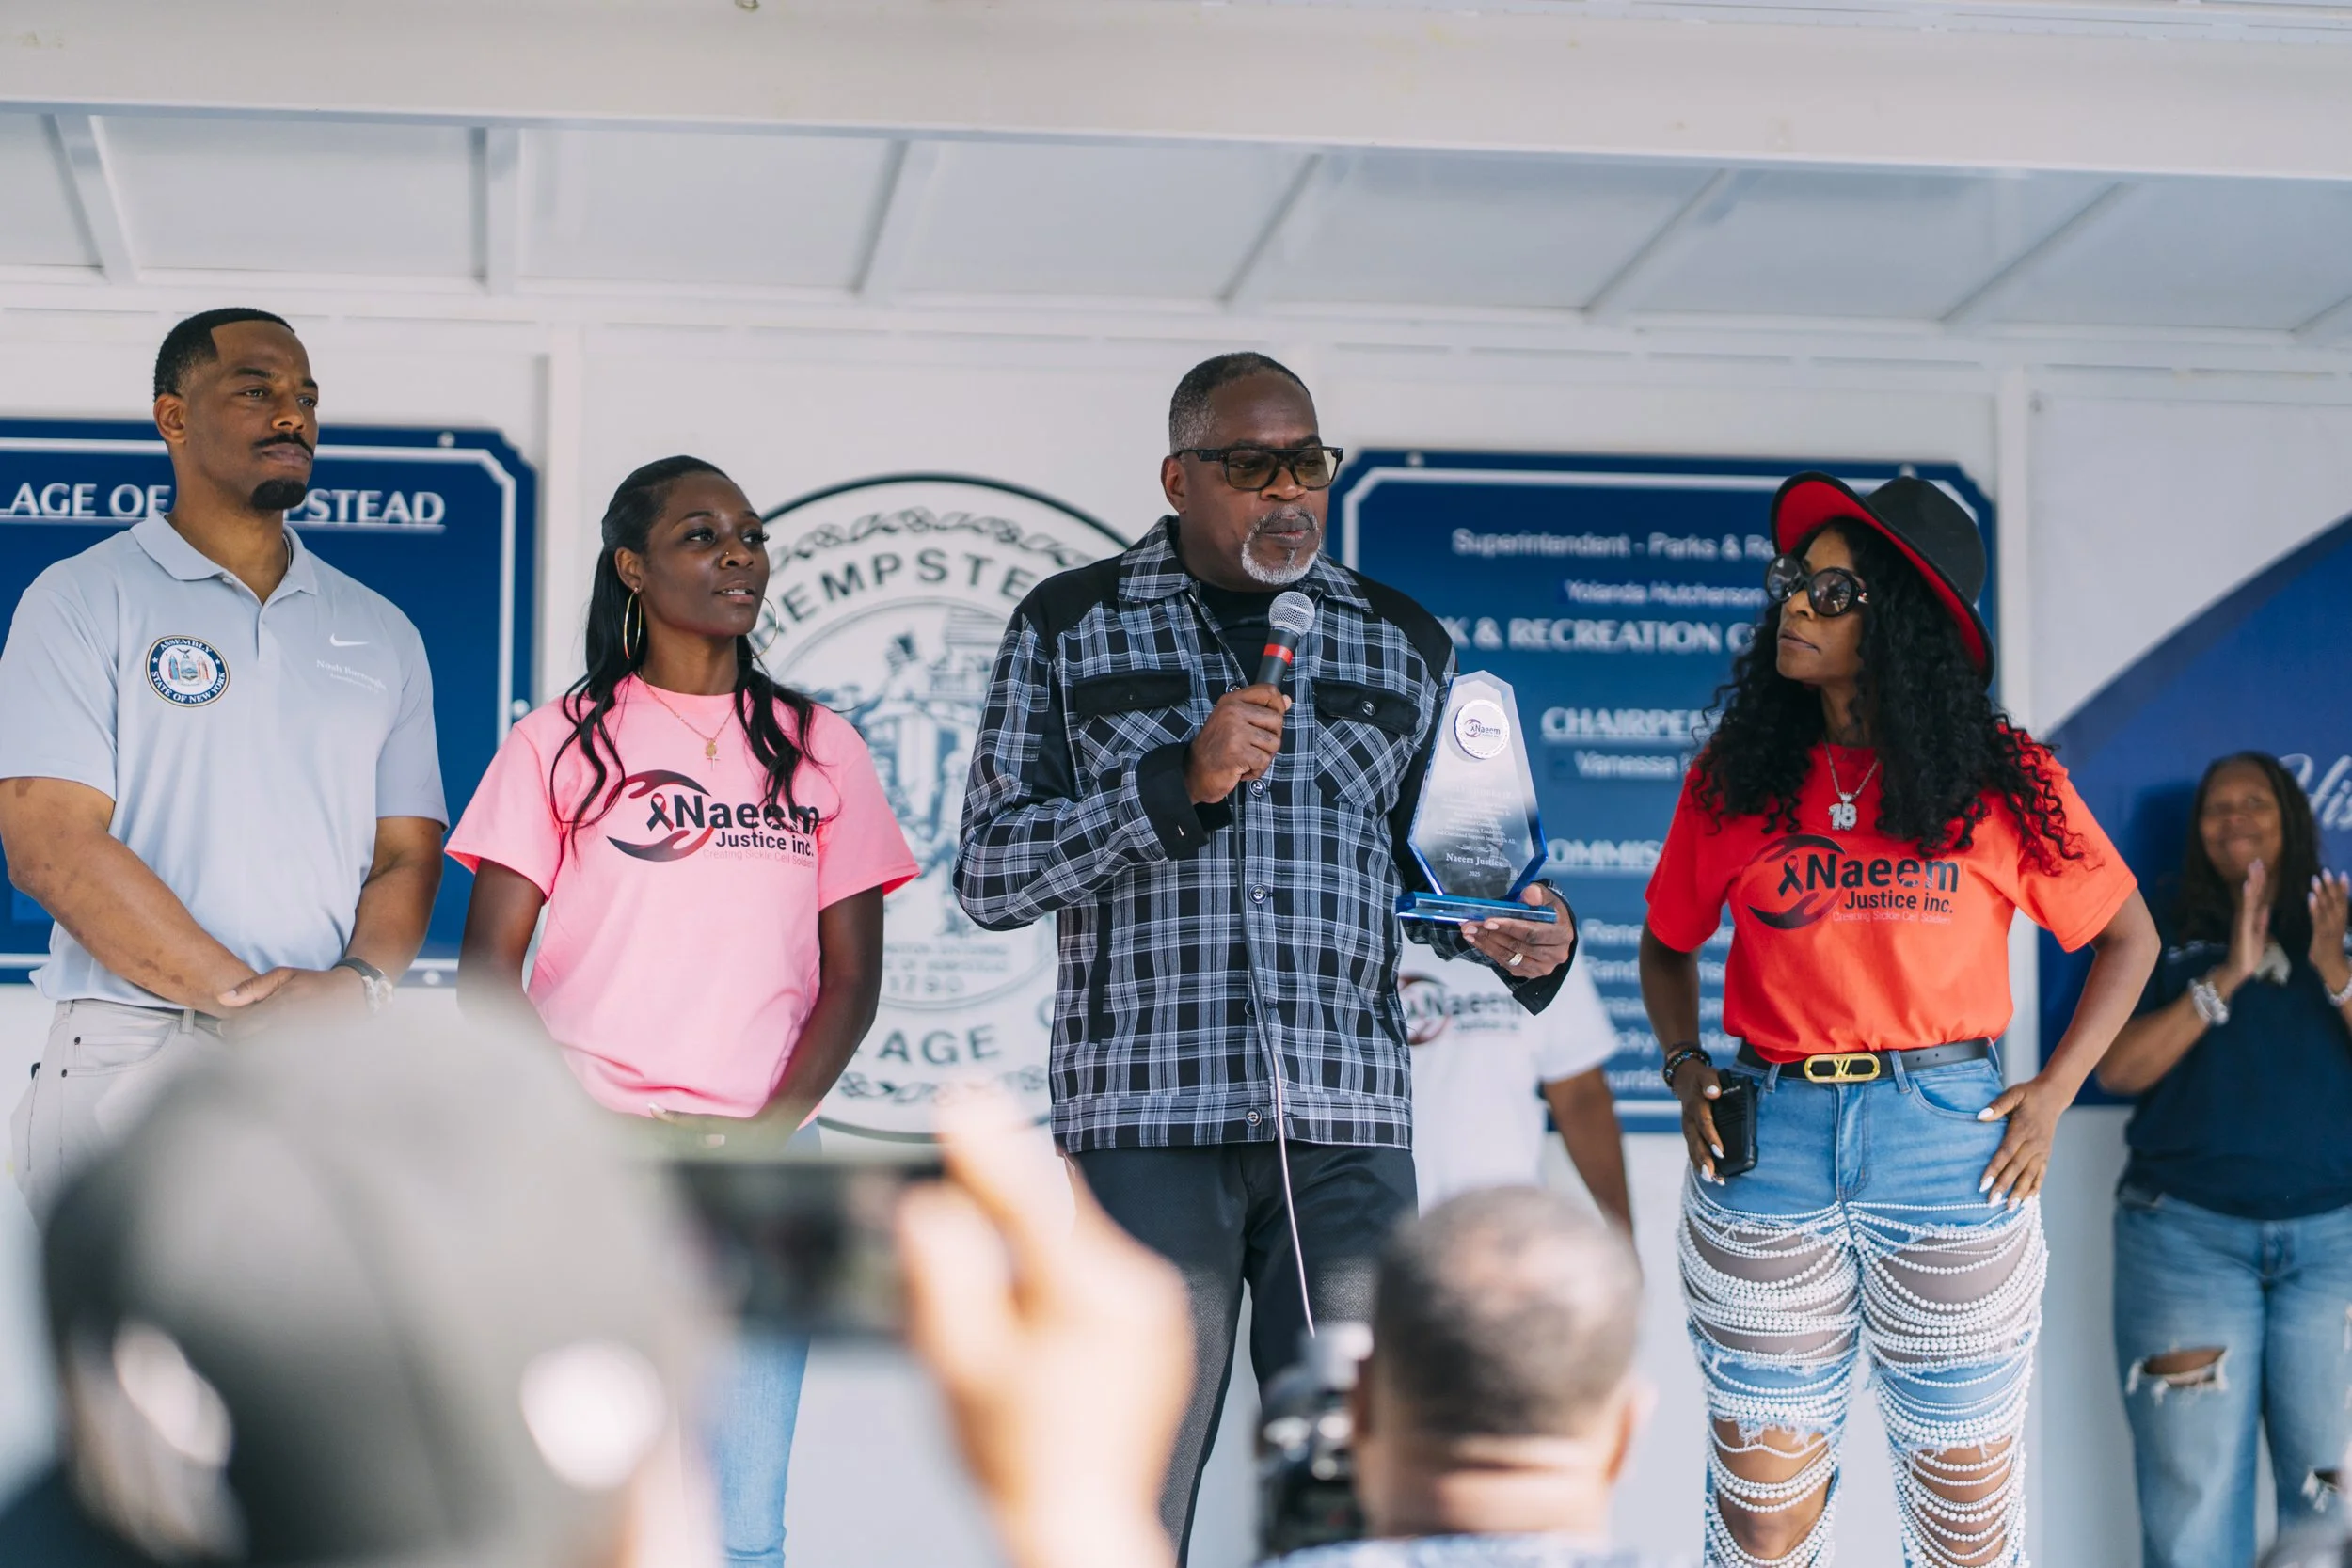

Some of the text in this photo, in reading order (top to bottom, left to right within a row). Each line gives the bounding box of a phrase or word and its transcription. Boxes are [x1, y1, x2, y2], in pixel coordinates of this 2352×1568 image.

[0, 483, 98, 518] AGE
[108, 484, 171, 518] OF
[1453, 529, 1630, 558] Superintendent
[1648, 532, 1717, 560] Parks
[1745, 534, 1775, 562] Re
[752, 548, 1035, 651] HEMPSTE
[160, 639, 213, 653] ASSEMBLY
[1473, 617, 1503, 650] &
[1508, 618, 1722, 654] RECREATION
[151, 671, 226, 703] STATE OF NEW YORK
[674, 794, 820, 836] Naeem
[1828, 803, 1857, 830] 18
[703, 849, 742, 861] Creating
[745, 849, 772, 860] Sickle
[774, 851, 790, 863] Cell
[716, 832, 814, 857] Justice inc.
[1446, 853, 1503, 866] Naeem Justice
[1806, 854, 1959, 892] Naeem
[1833, 911, 1870, 923] Creating
[1873, 911, 1900, 922] Sickle
[1902, 911, 1919, 922] Cell
[1844, 890, 1953, 913] Justice inc.
[858, 1023, 1004, 1065] AGE
